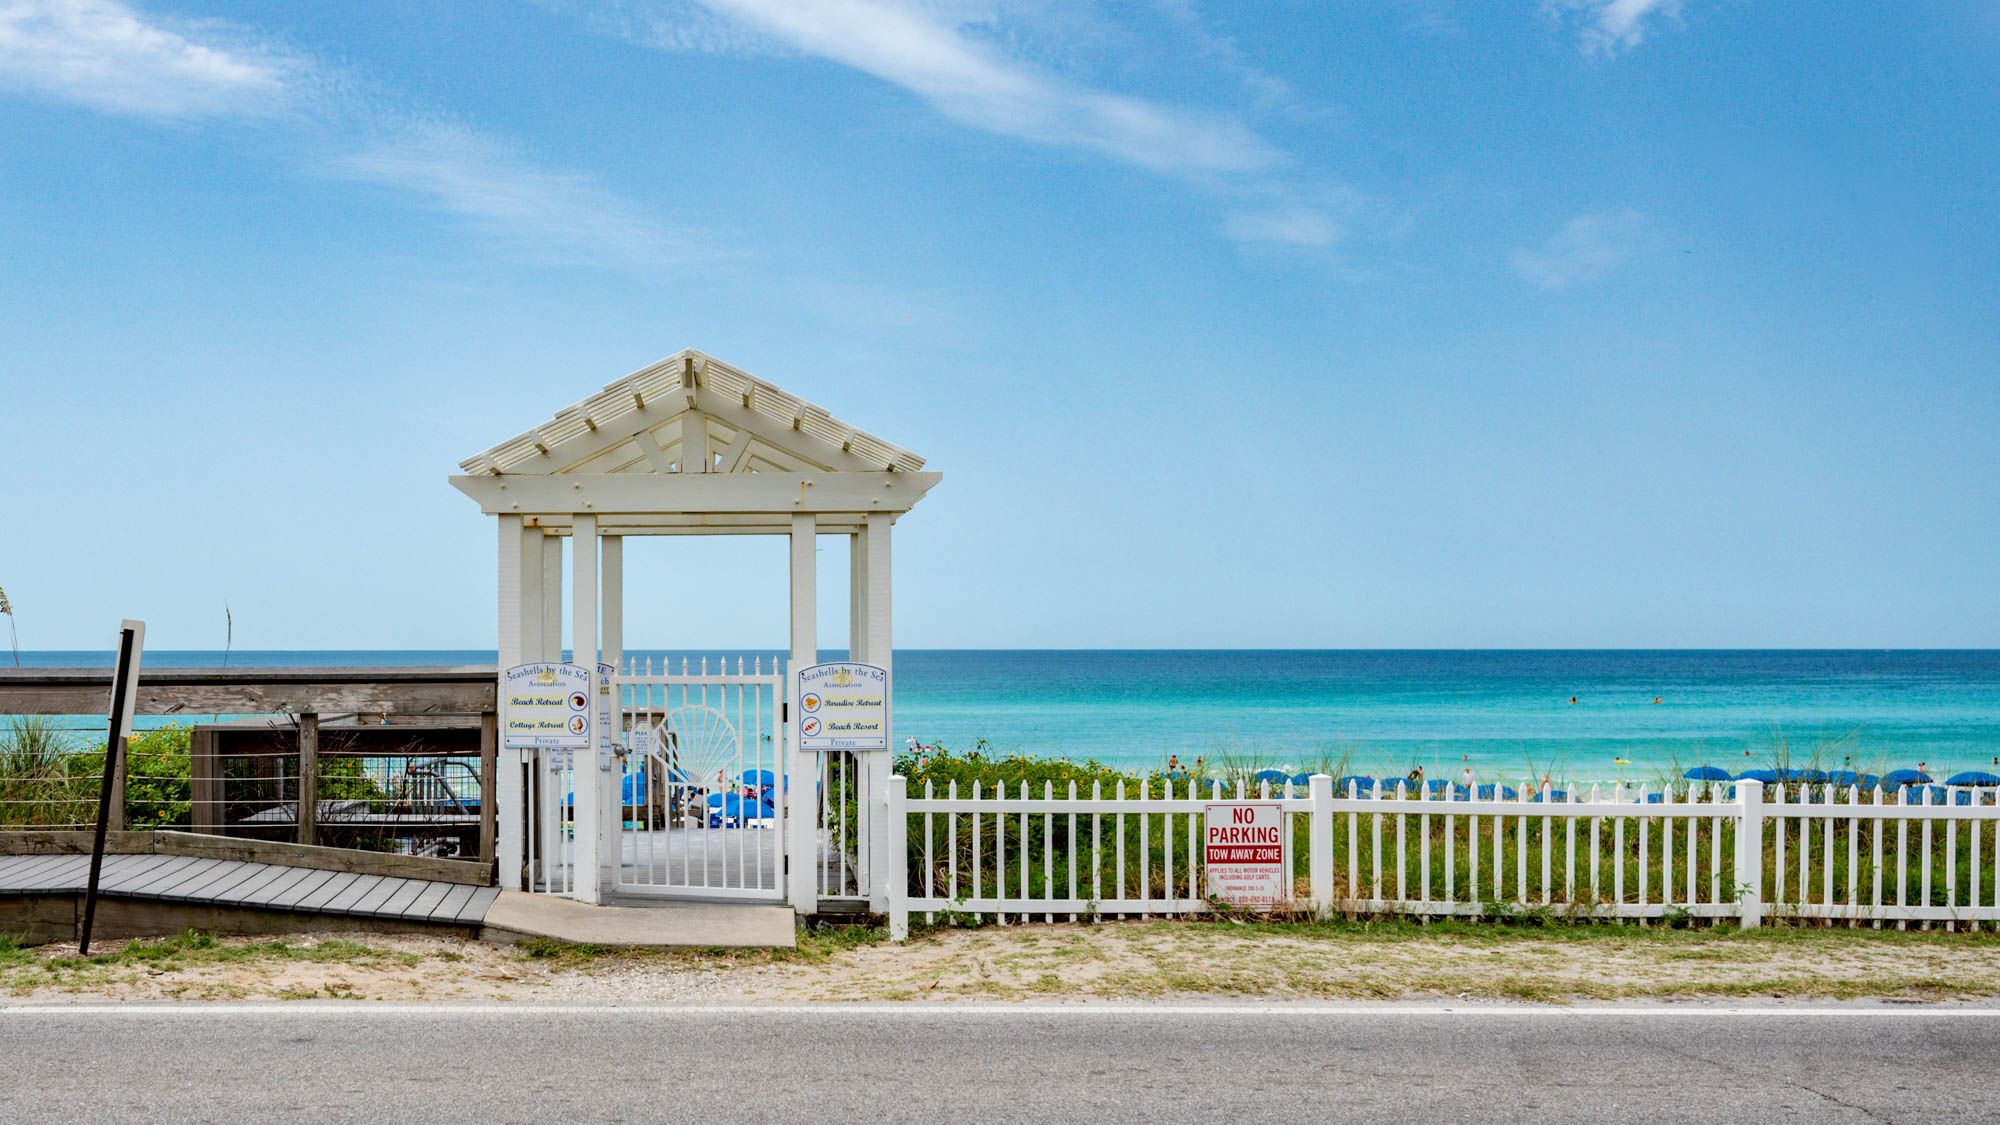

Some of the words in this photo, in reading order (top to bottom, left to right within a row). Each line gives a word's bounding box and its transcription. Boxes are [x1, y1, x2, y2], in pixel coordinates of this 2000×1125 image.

[507, 666, 543, 682] Seashells
[546, 665, 556, 674] by
[560, 667, 573, 676] the
[575, 671, 588, 682] Sea
[801, 667, 838, 682] Seashells
[841, 666, 852, 676] by
[855, 667, 869, 677] the
[870, 671, 883, 682] Sea
[511, 697, 534, 706] Beach
[535, 697, 563, 706] Retreat
[824, 699, 854, 707] Paradise
[855, 699, 882, 707] Retreat
[509, 721, 535, 730] Cottage
[537, 721, 564, 729] Retreat
[828, 722, 851, 731] Beach
[852, 722, 879, 731] Resort
[534, 737, 560, 745] Private
[830, 738, 857, 746] Private
[1233, 807, 1255, 824] NO
[1209, 827, 1278, 843] PARKING
[1209, 848, 1229, 860] TOW
[1230, 848, 1254, 860] AWAY
[1256, 848, 1280, 860] ZONE
